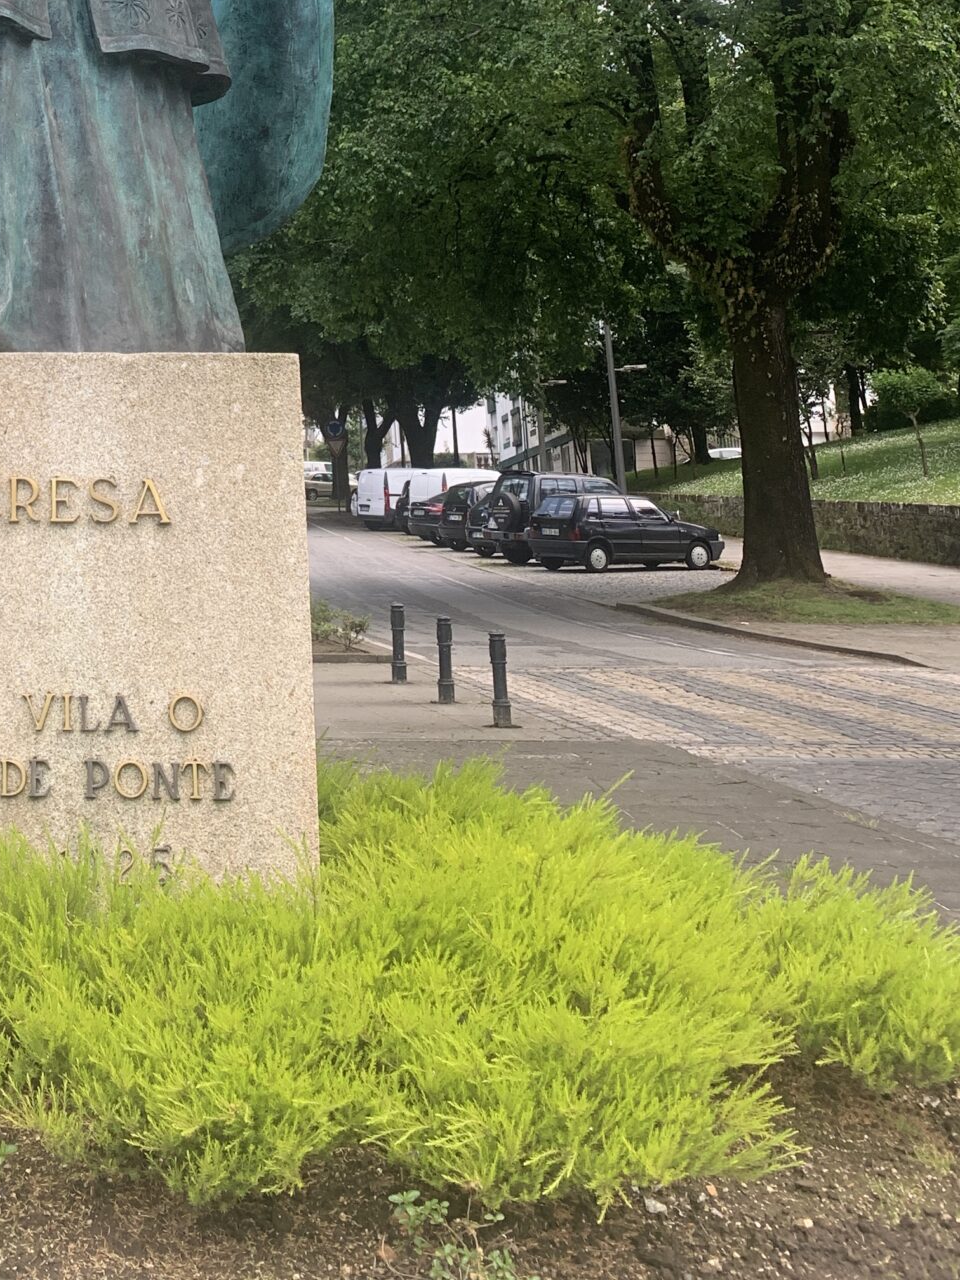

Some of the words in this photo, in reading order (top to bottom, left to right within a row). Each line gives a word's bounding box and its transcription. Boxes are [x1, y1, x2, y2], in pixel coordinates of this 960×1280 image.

[21, 690, 140, 733] VILA
[169, 693, 206, 733] O
[0, 755, 52, 799] DE
[84, 757, 237, 802] PONTE
